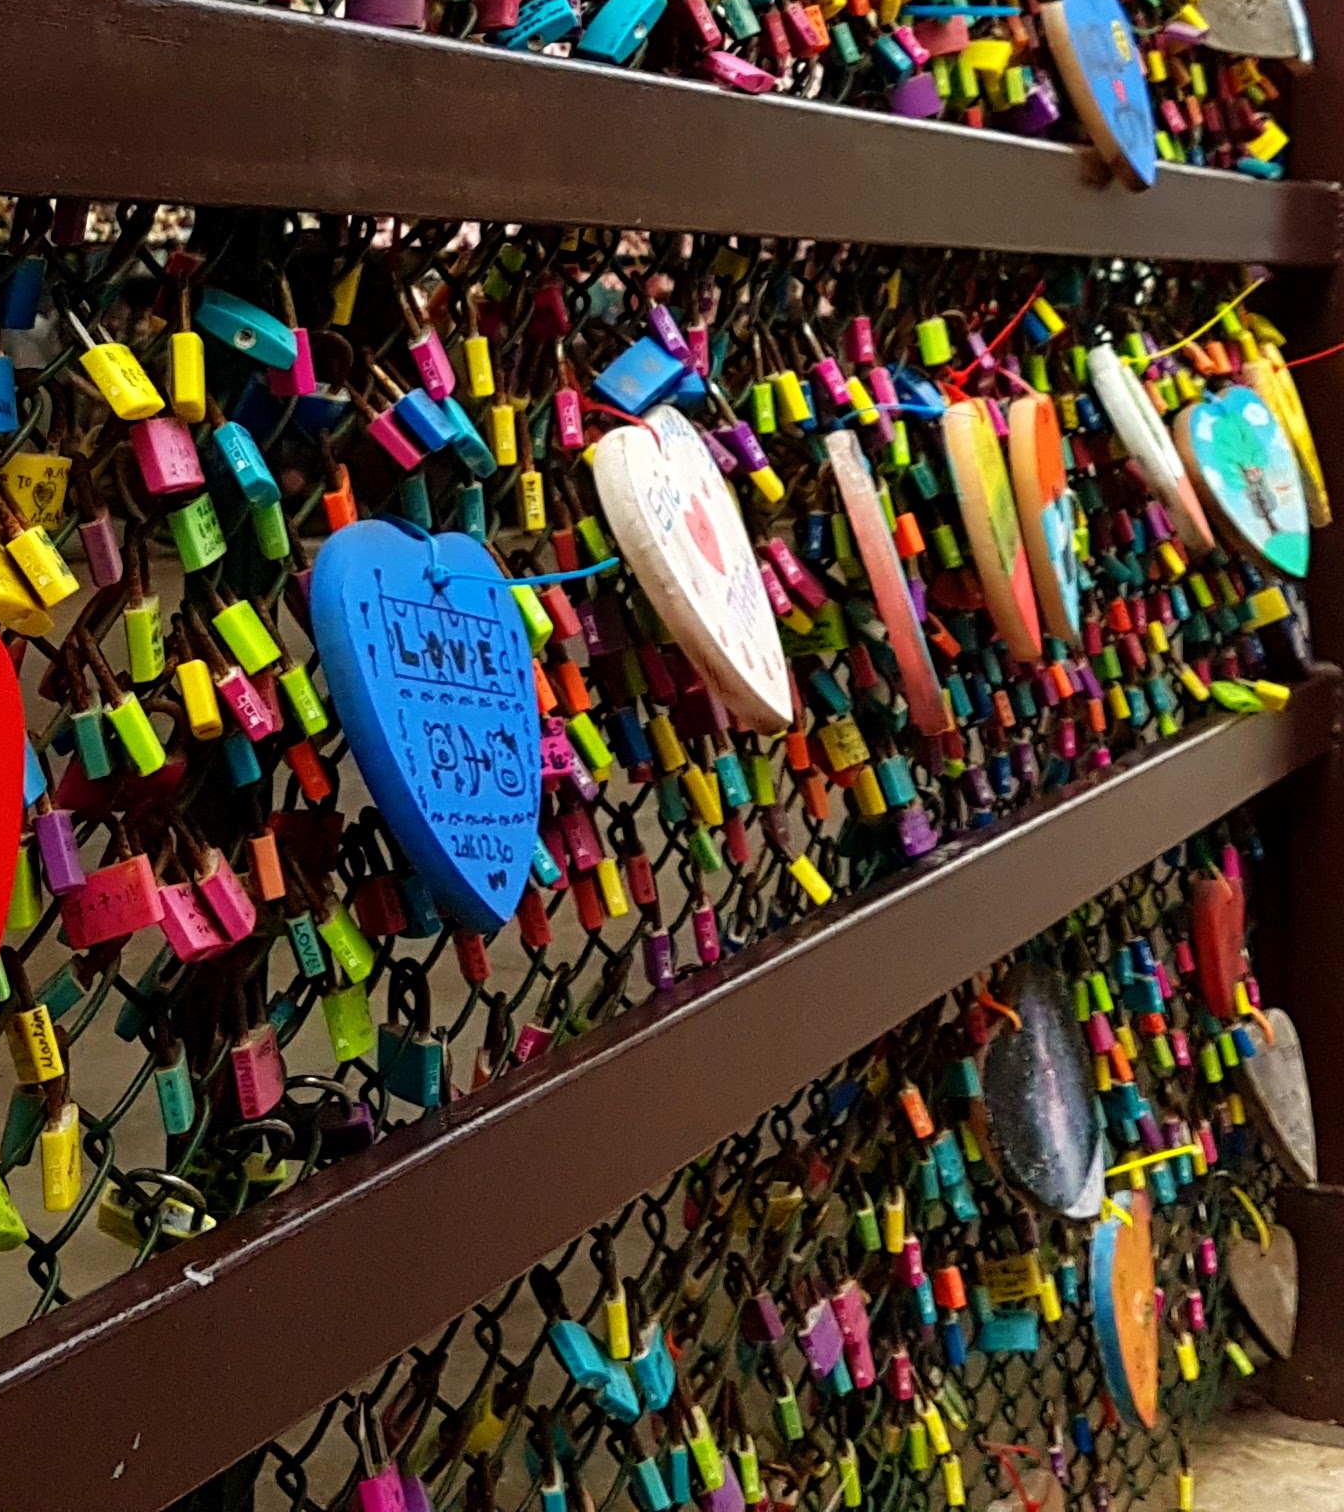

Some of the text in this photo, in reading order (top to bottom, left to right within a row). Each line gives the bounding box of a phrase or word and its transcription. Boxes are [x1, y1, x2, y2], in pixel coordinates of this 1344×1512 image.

[394, 620, 497, 675] LOVE
[237, 693, 264, 730] bnb
[293, 922, 321, 973] LOVE
